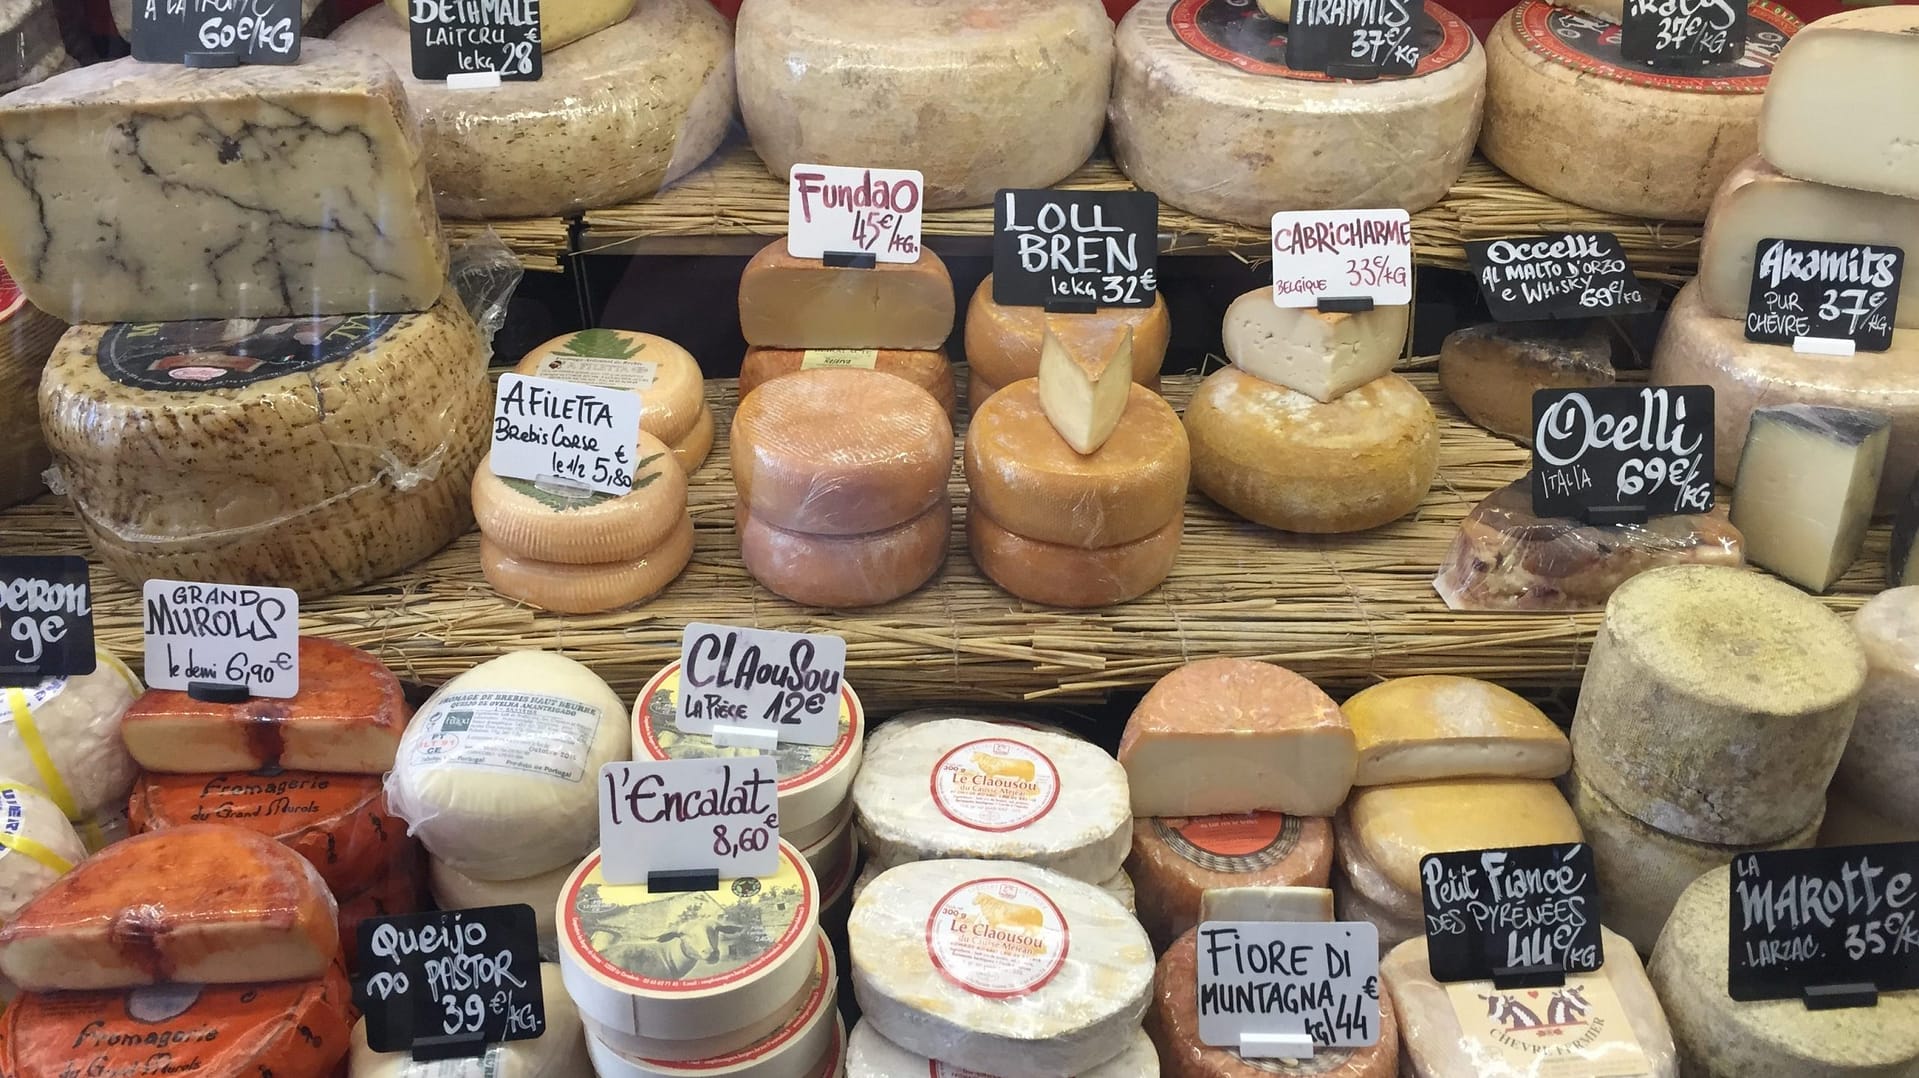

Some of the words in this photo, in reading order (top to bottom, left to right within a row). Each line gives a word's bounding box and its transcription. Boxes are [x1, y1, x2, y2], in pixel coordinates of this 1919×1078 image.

[1003, 193, 1124, 233] LOU
[1018, 233, 1138, 274] BREN
[1487, 234, 1611, 264] Occelli
[1482, 265, 1500, 292] AL
[1505, 261, 1562, 281] MALTO
[1764, 291, 1803, 311] PUR
[1536, 387, 1703, 466] Ocelli
[167, 643, 180, 677] le
[185, 648, 216, 678] demi
[685, 694, 702, 719] LA
[201, 777, 330, 797] Fromagerie
[952, 773, 968, 783] Le
[972, 775, 1037, 791] Claousou
[1737, 855, 1760, 877] LA
[950, 920, 967, 933] Le
[972, 923, 1043, 949] Claousou
[1427, 909, 1466, 936] DES
[371, 913, 487, 965] Queijo
[424, 949, 527, 1003] PASTOR
[1201, 979, 1335, 1015] MUNTAGNA
